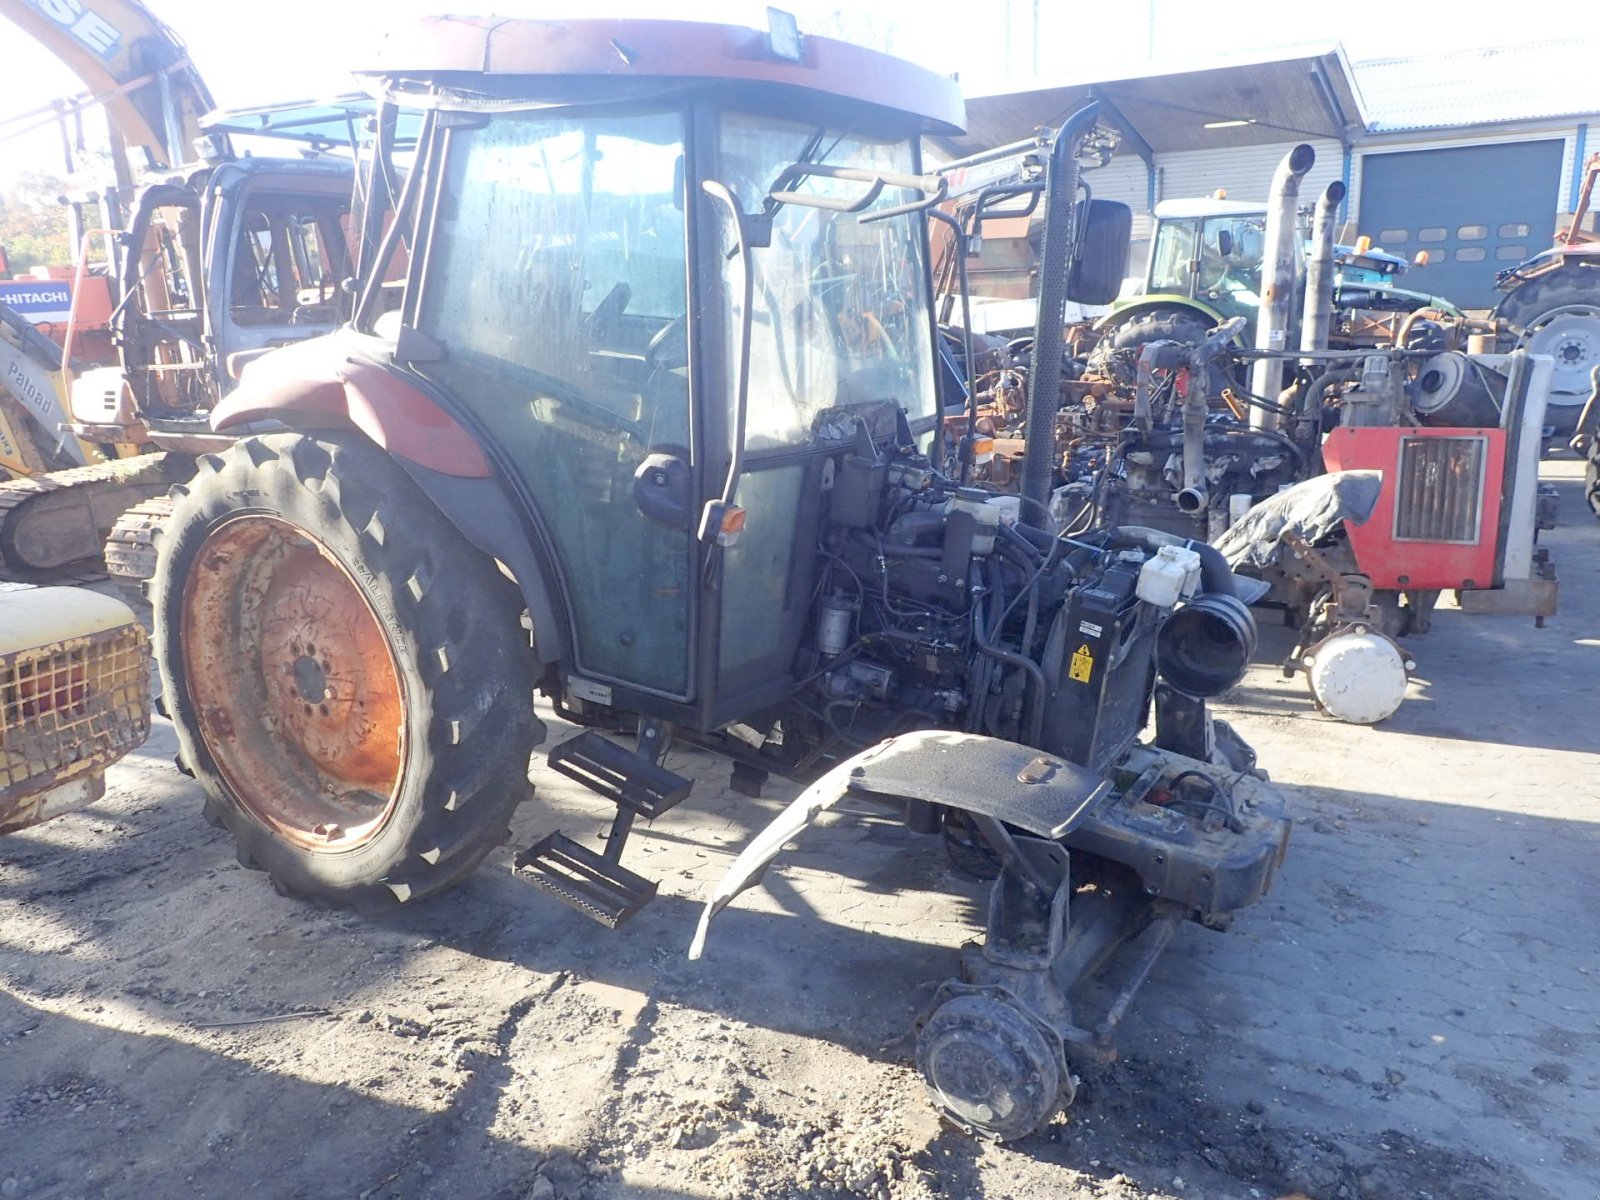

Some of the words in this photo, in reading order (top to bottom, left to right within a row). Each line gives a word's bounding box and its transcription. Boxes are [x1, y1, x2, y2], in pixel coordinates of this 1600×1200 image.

[32, 0, 121, 54] SE
[5, 291, 69, 305] HITACHI
[8, 361, 52, 414] Paload
